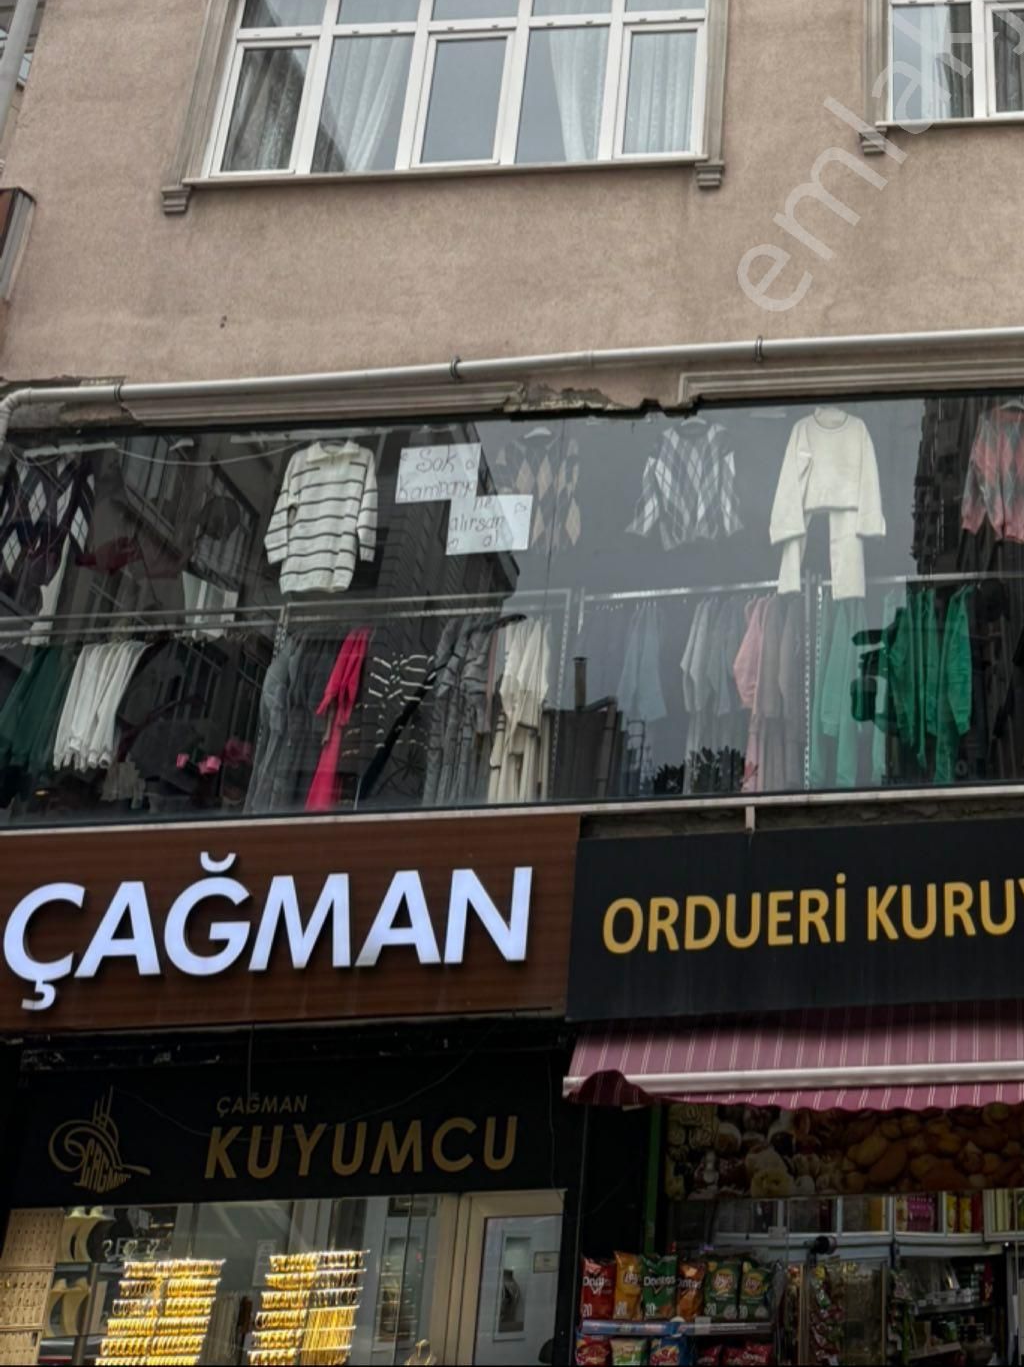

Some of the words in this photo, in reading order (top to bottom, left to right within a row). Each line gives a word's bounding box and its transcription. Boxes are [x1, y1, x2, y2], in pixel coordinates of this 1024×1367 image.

[3, 852, 533, 1010] ÇAĞMAN
[602, 873, 846, 954] ORDUERİ
[216, 1093, 308, 1118] ÇAĞMAN
[203, 1115, 518, 1180] KUYUMCU
